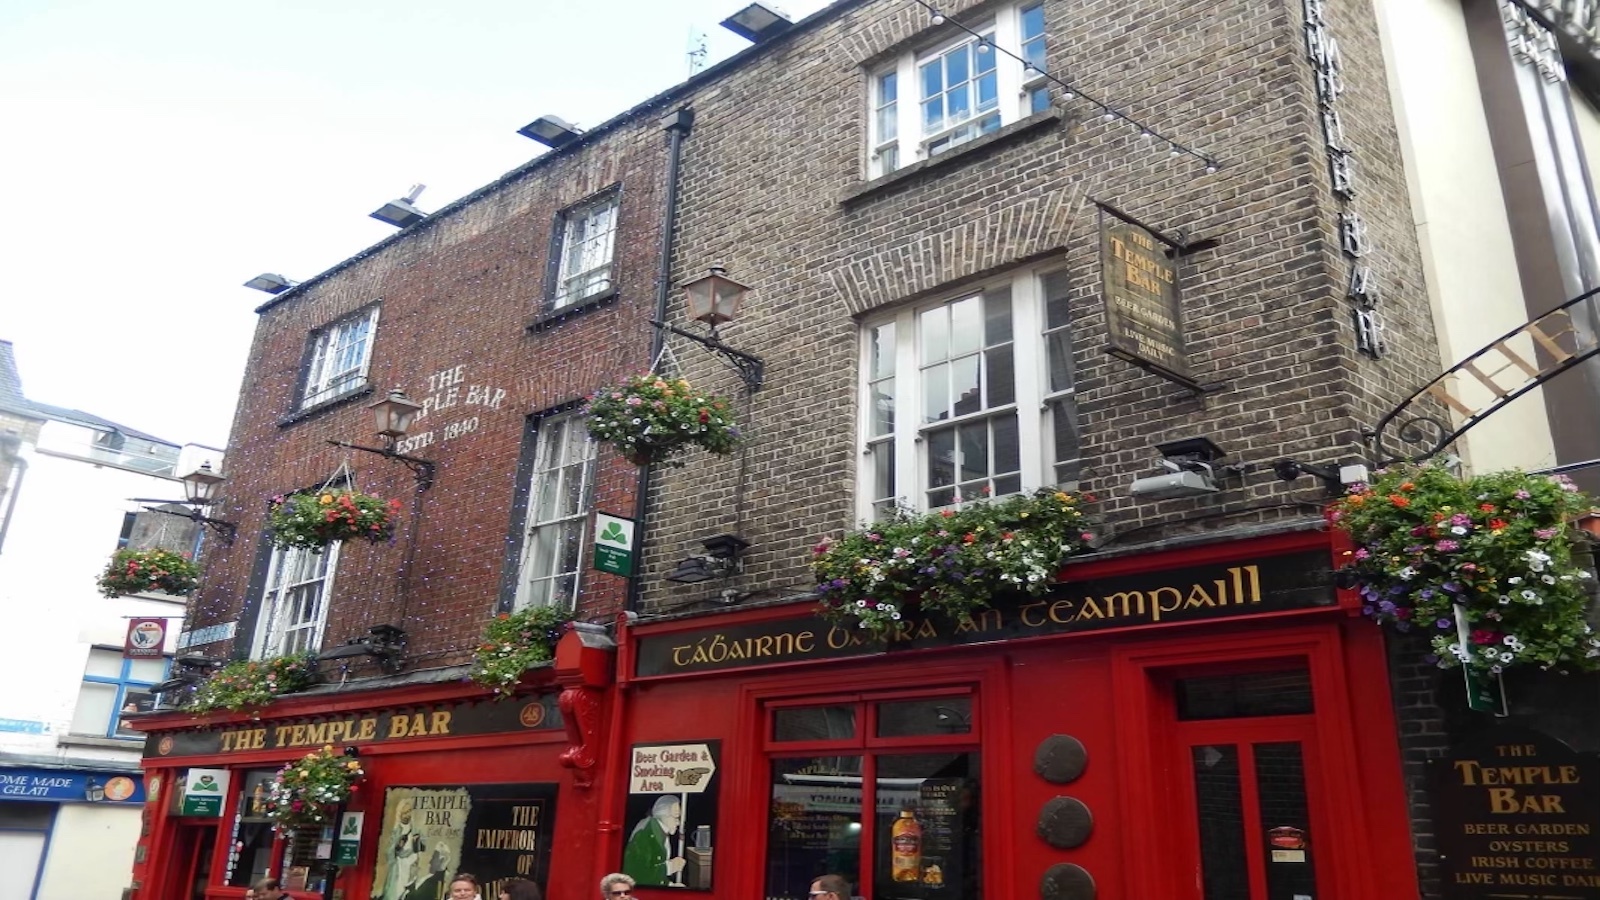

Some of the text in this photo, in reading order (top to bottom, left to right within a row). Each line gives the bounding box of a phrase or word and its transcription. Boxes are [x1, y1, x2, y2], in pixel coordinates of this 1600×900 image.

[1130, 230, 1154, 251] THE
[1110, 236, 1174, 285] TEMPLE
[1126, 262, 1161, 297] BAR
[1124, 327, 1176, 357] LIVE MUSIC
[427, 364, 467, 393] THE
[411, 385, 506, 423] PLE BAR
[443, 416, 479, 441] 1840
[221, 711, 451, 751] THE TEMPLE BAR
[635, 751, 657, 764] Beer
[660, 749, 698, 763] Garden
[1496, 744, 1536, 757] THE
[634, 765, 675, 779] Smoking
[1454, 760, 1580, 786] TEMPLE
[3, 785, 49, 796] GELATI
[31, 777, 73, 788] MADE
[640, 779, 664, 791] Area
[411, 795, 467, 810] TEMPLE
[1488, 787, 1566, 814] BAR
[425, 811, 452, 827] BAR
[513, 806, 540, 826] THE
[1464, 823, 1591, 835] BEER GARDEN
[476, 829, 535, 850] EMPEROR
[1489, 840, 1570, 853] OYSTERS
[517, 855, 534, 875] OF
[1471, 856, 1596, 870] IRISH COFFEE
[1455, 872, 1494, 884] LIVE
[1499, 873, 1557, 886] MUSIC
